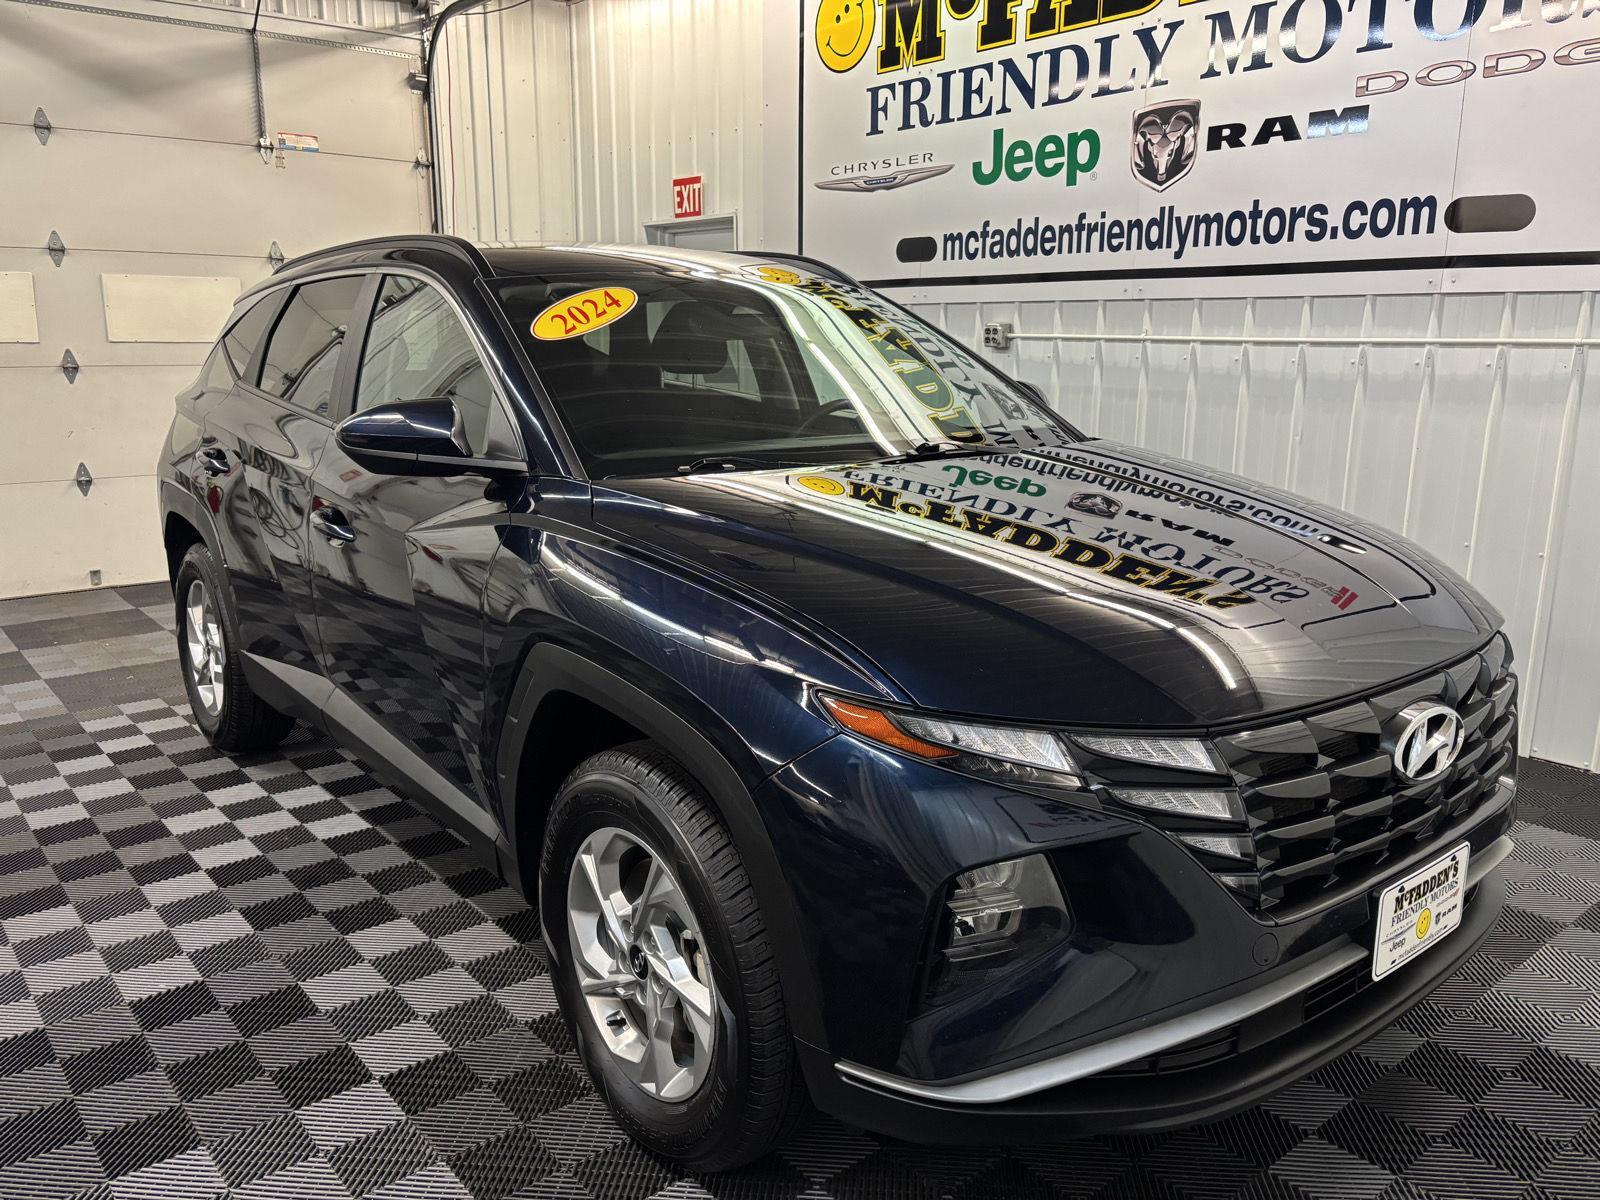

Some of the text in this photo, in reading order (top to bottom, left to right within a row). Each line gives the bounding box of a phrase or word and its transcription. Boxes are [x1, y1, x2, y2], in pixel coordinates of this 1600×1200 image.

[866, 20, 1184, 136] FRIENDLY
[1206, 105, 1370, 152] RAM
[831, 152, 934, 176] CHRYSLER
[972, 128, 1100, 187] Jeep
[673, 182, 701, 214] EXIT
[943, 193, 1437, 262] mcfaddenfriendlymotors.com
[551, 290, 622, 335] 2024
[1391, 896, 1430, 927] FRIENDLY
[1430, 877, 1459, 906] MOTORS
[1389, 936, 1406, 953] Jeep
